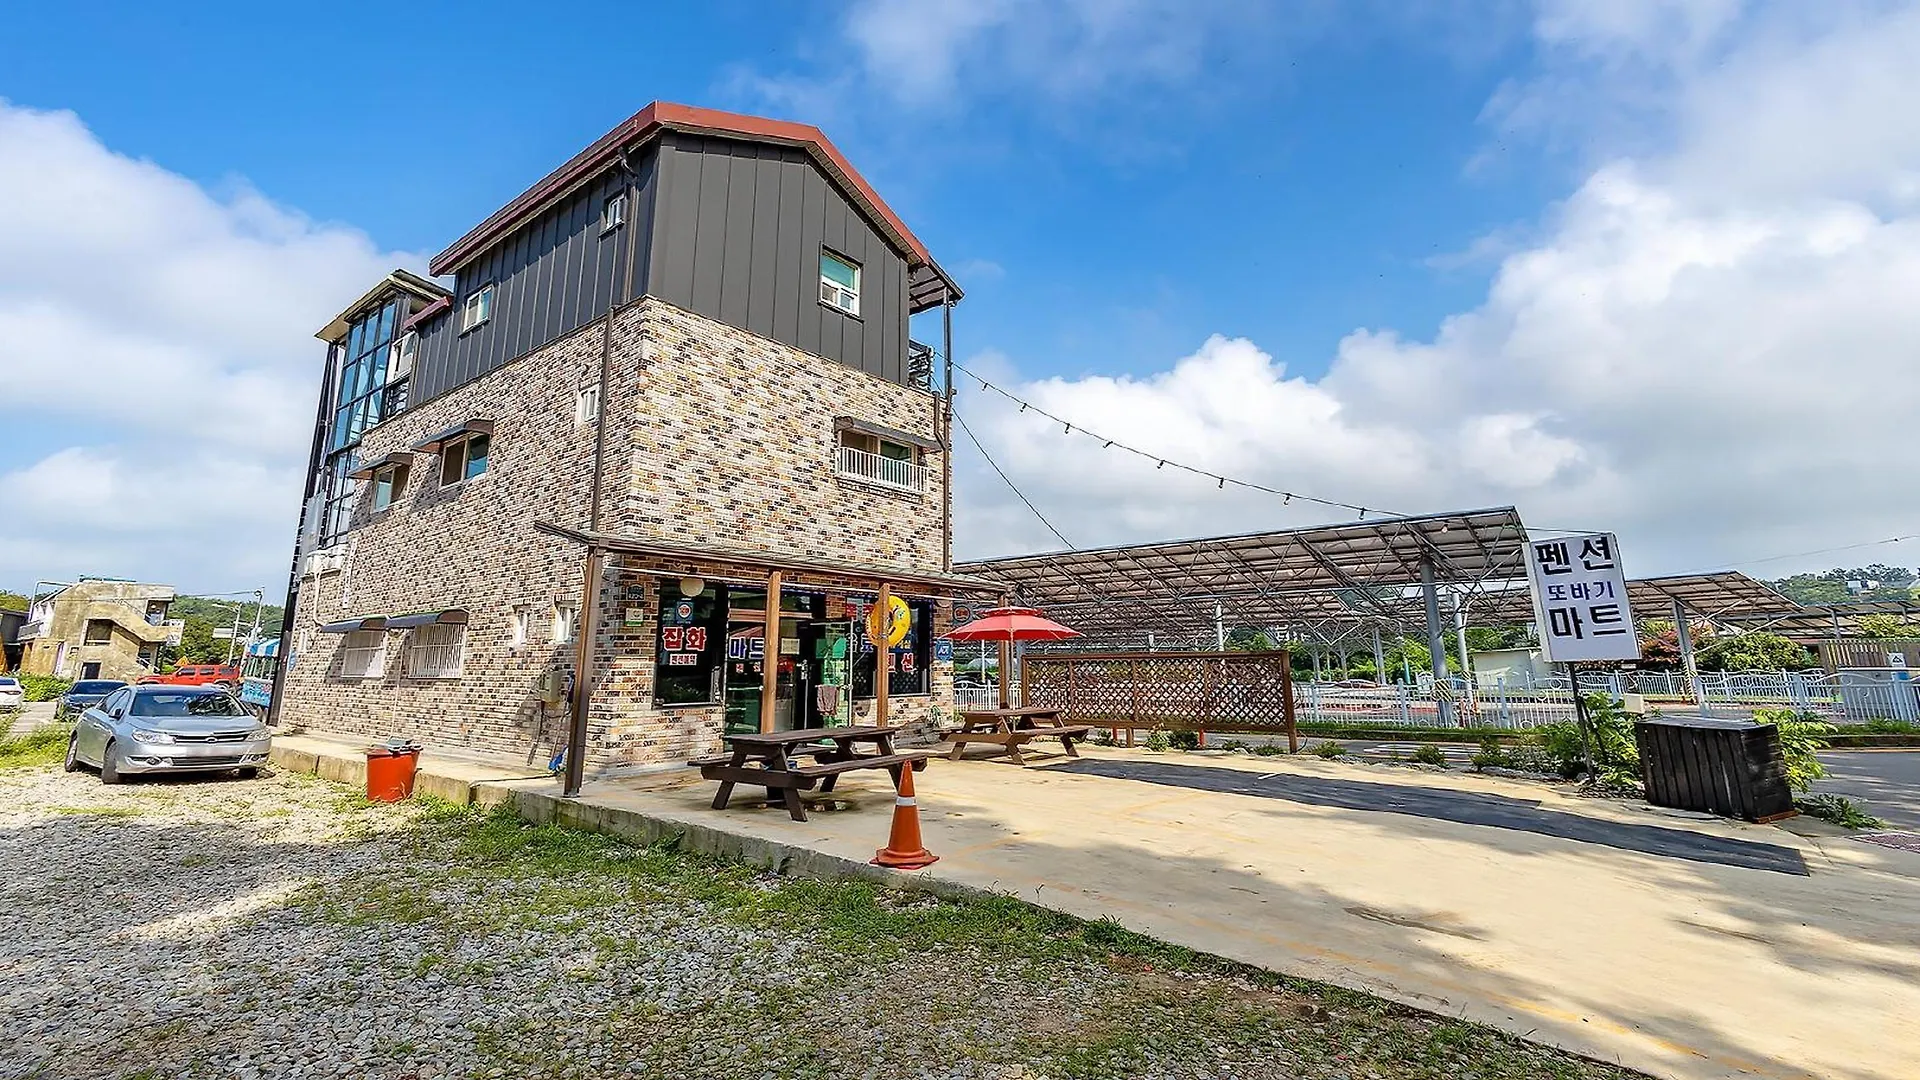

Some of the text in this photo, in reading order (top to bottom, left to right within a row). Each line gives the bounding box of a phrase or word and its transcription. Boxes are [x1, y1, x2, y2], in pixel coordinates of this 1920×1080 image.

[1534, 536, 1615, 576] 펜션
[1547, 580, 1615, 601] 또바기
[1548, 603, 1627, 640] 마트
[662, 627, 707, 651] 잡화
[729, 637, 764, 659] 마트
